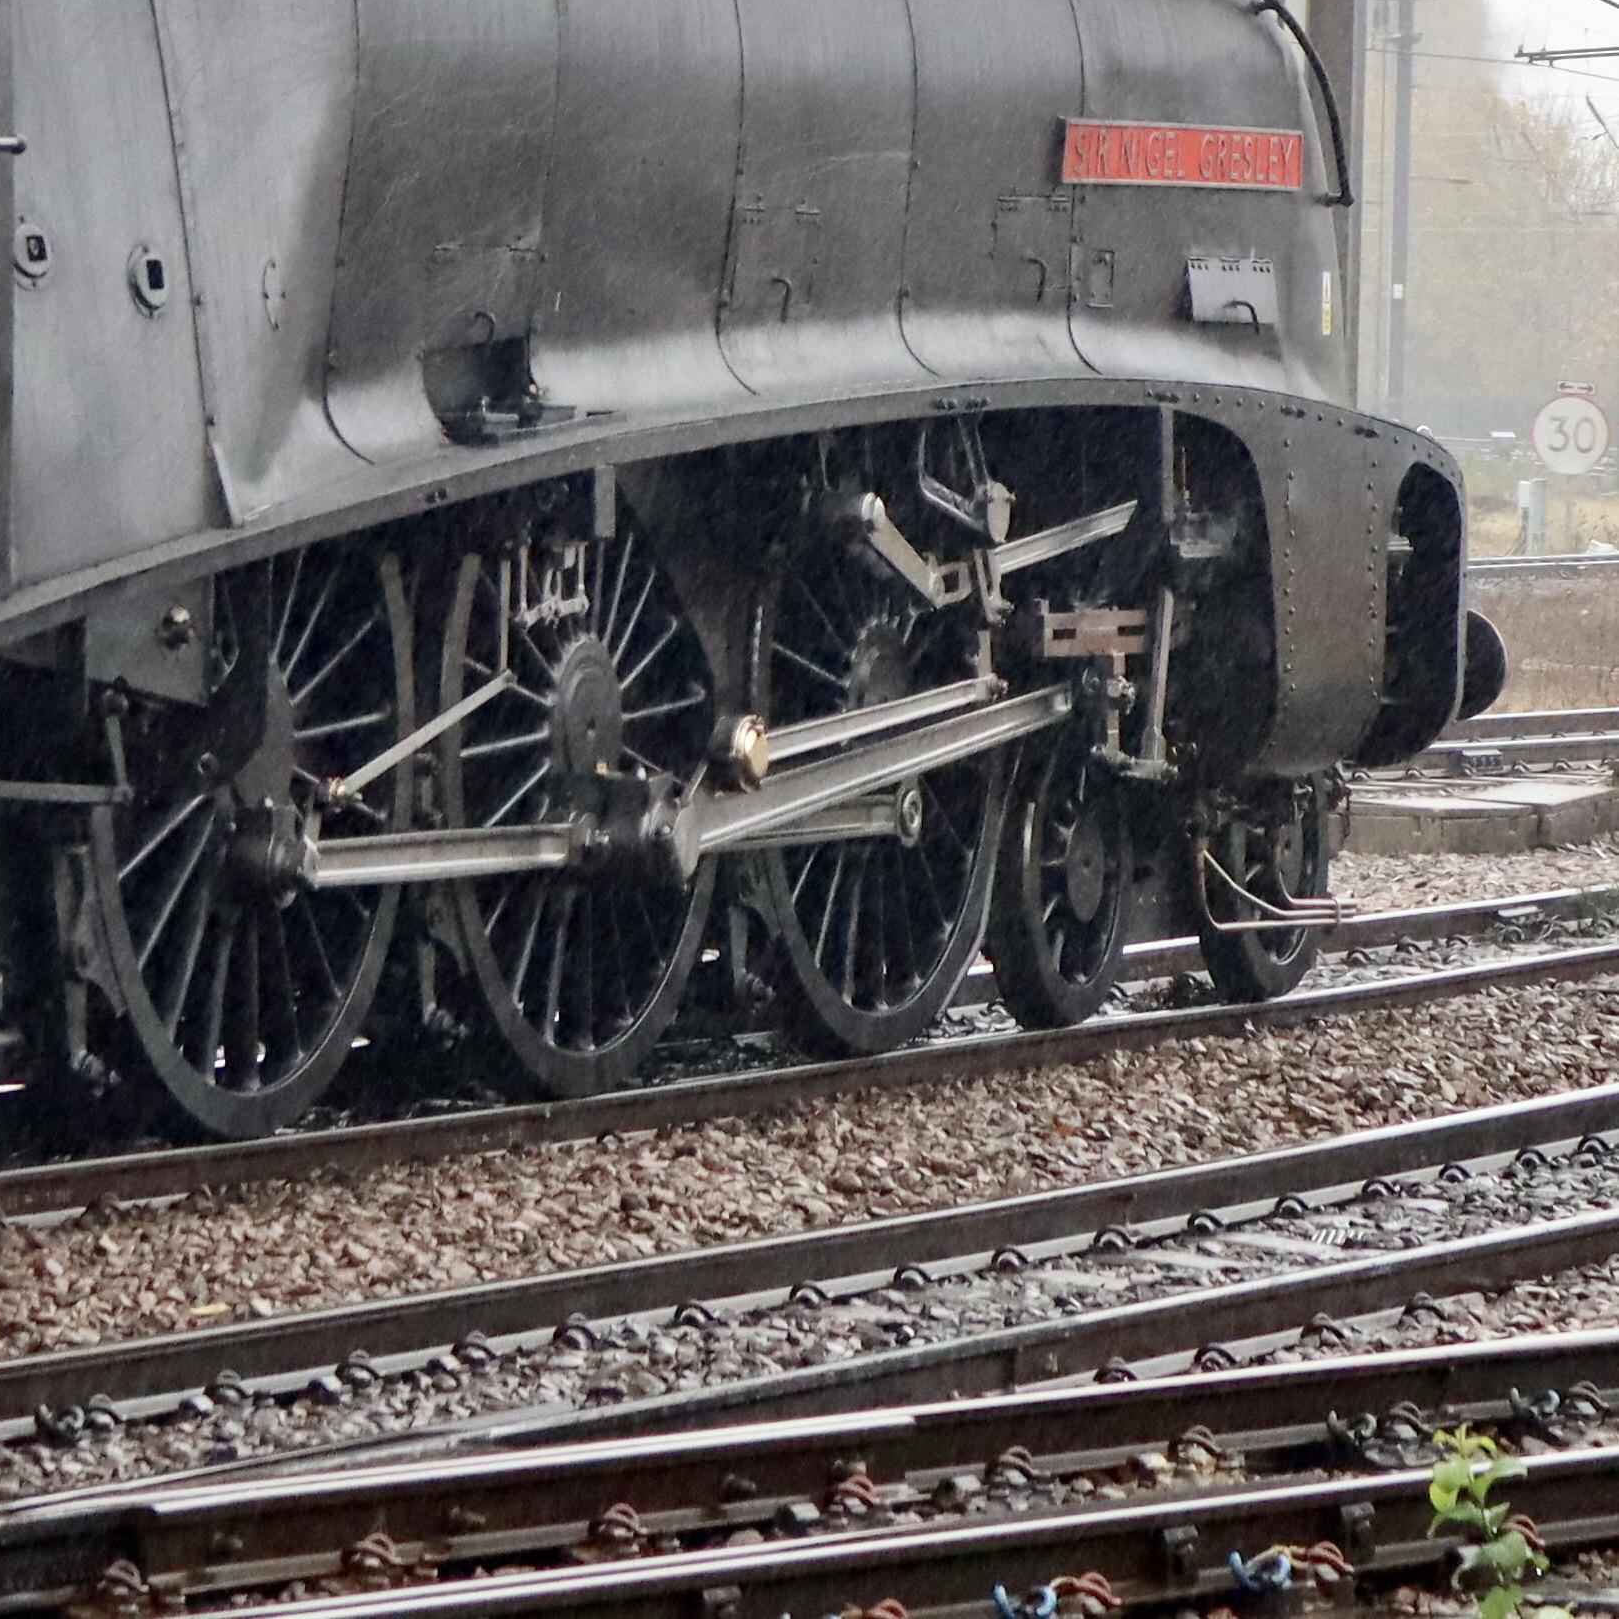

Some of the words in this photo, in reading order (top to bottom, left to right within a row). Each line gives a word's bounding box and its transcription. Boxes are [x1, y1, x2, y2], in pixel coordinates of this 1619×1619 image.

[1072, 130, 1107, 177] SIR
[1119, 131, 1186, 178] NIGEL
[1199, 133, 1295, 183] GRESLEY
[1547, 416, 1597, 454] 30
